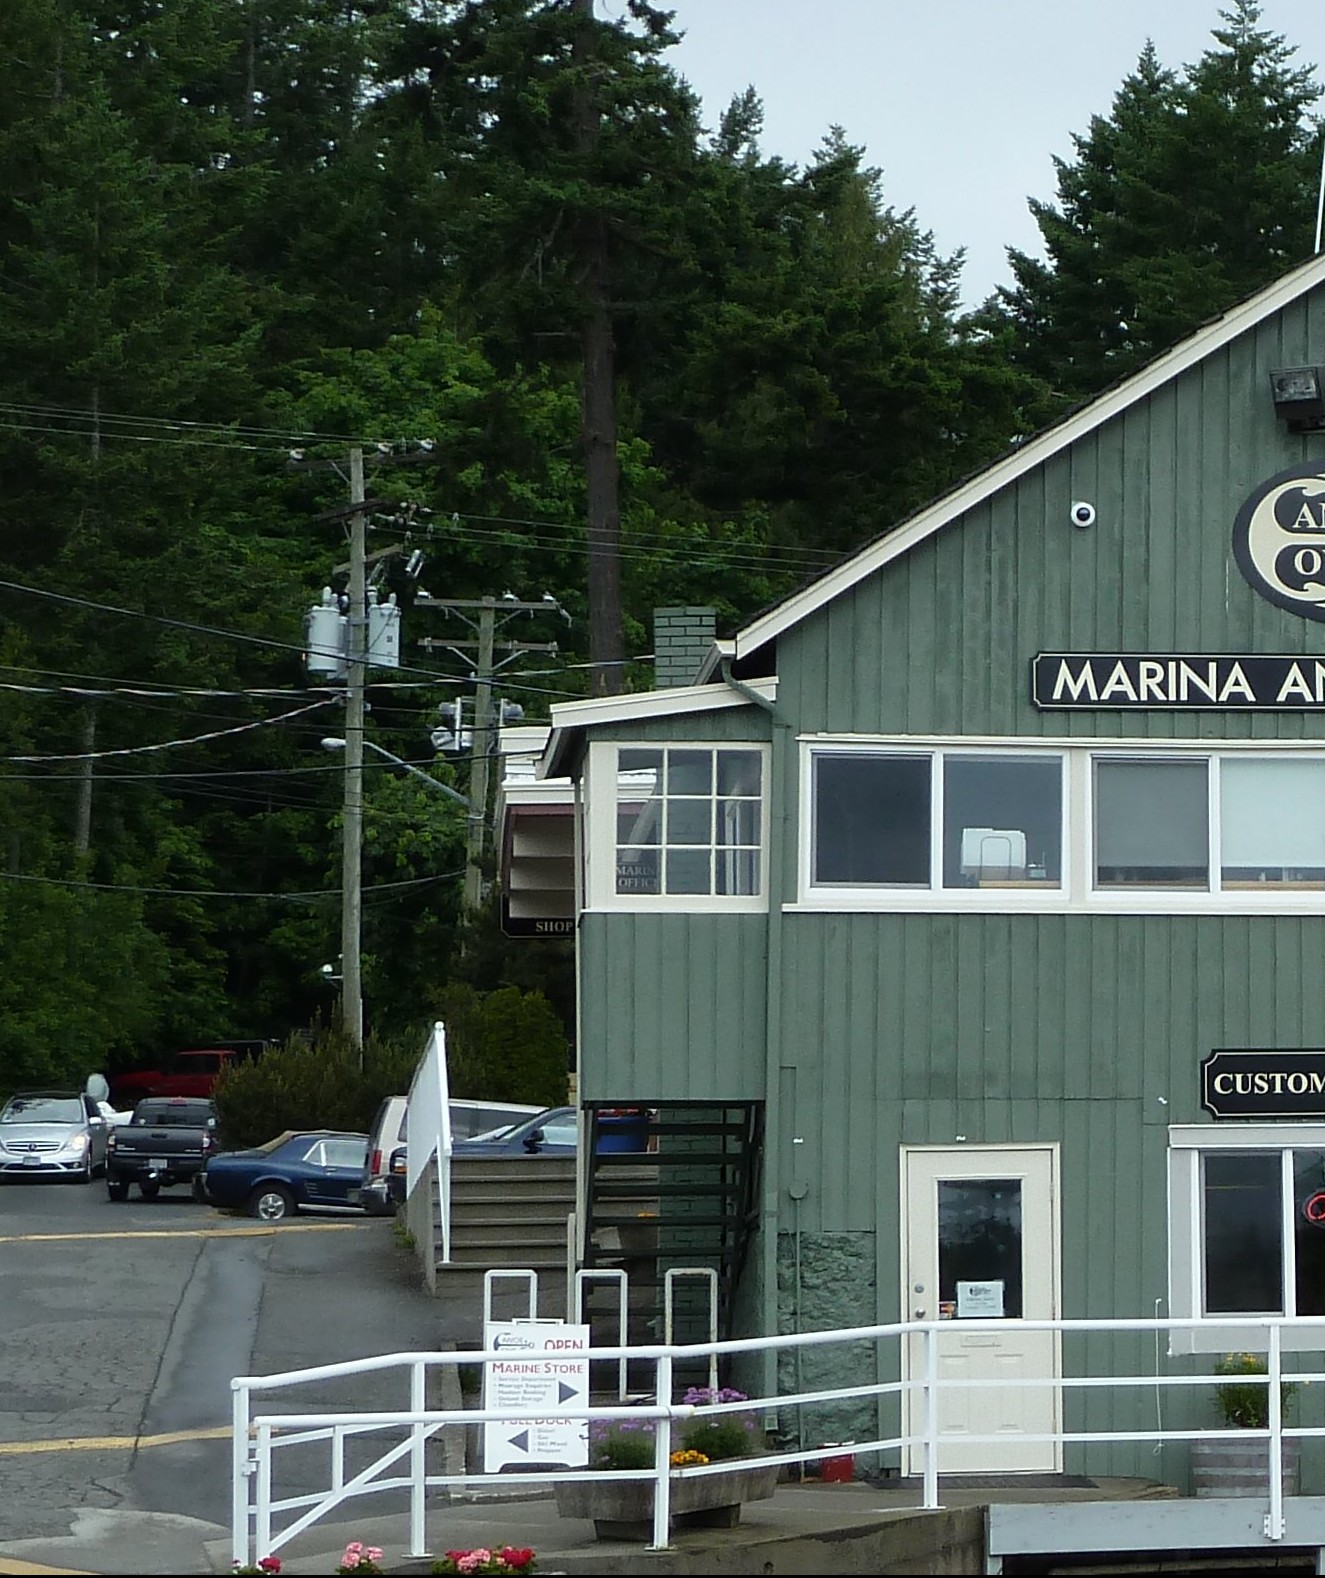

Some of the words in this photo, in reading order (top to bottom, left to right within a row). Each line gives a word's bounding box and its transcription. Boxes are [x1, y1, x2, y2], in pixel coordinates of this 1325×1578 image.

[1052, 659, 1256, 702] MARINA
[535, 921, 574, 933] SHOP
[492, 1362, 540, 1373] MARINE
[544, 1362, 584, 1374] STORE
